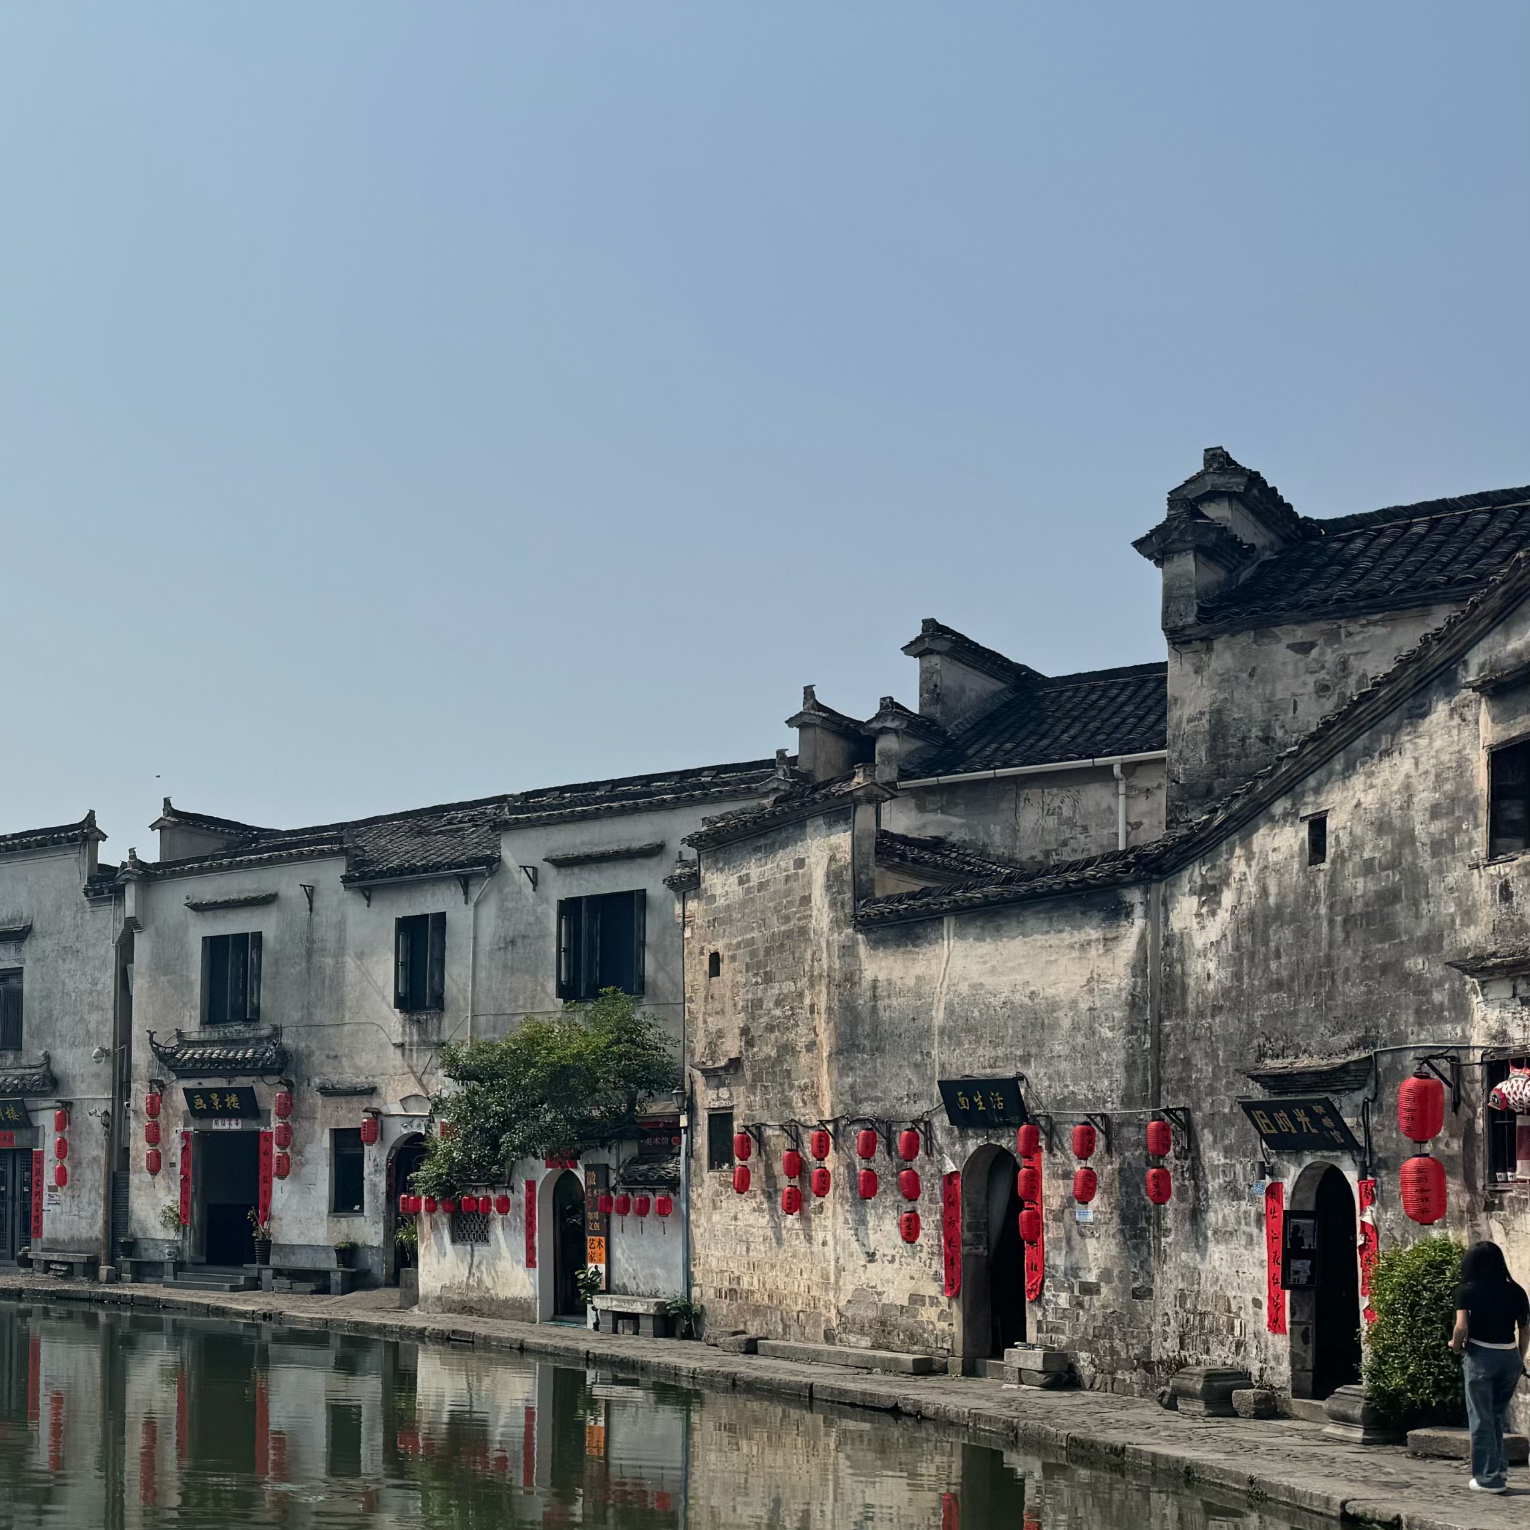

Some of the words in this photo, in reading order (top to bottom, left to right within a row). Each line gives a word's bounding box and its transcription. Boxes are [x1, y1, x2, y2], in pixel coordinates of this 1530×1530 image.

[193, 1092, 241, 1111] 画景楼
[957, 1090, 1005, 1112] 面生活
[1252, 1107, 1319, 1135] 旧时光
[588, 1221, 601, 1232] 文创
[588, 1238, 605, 1251] 艺术
